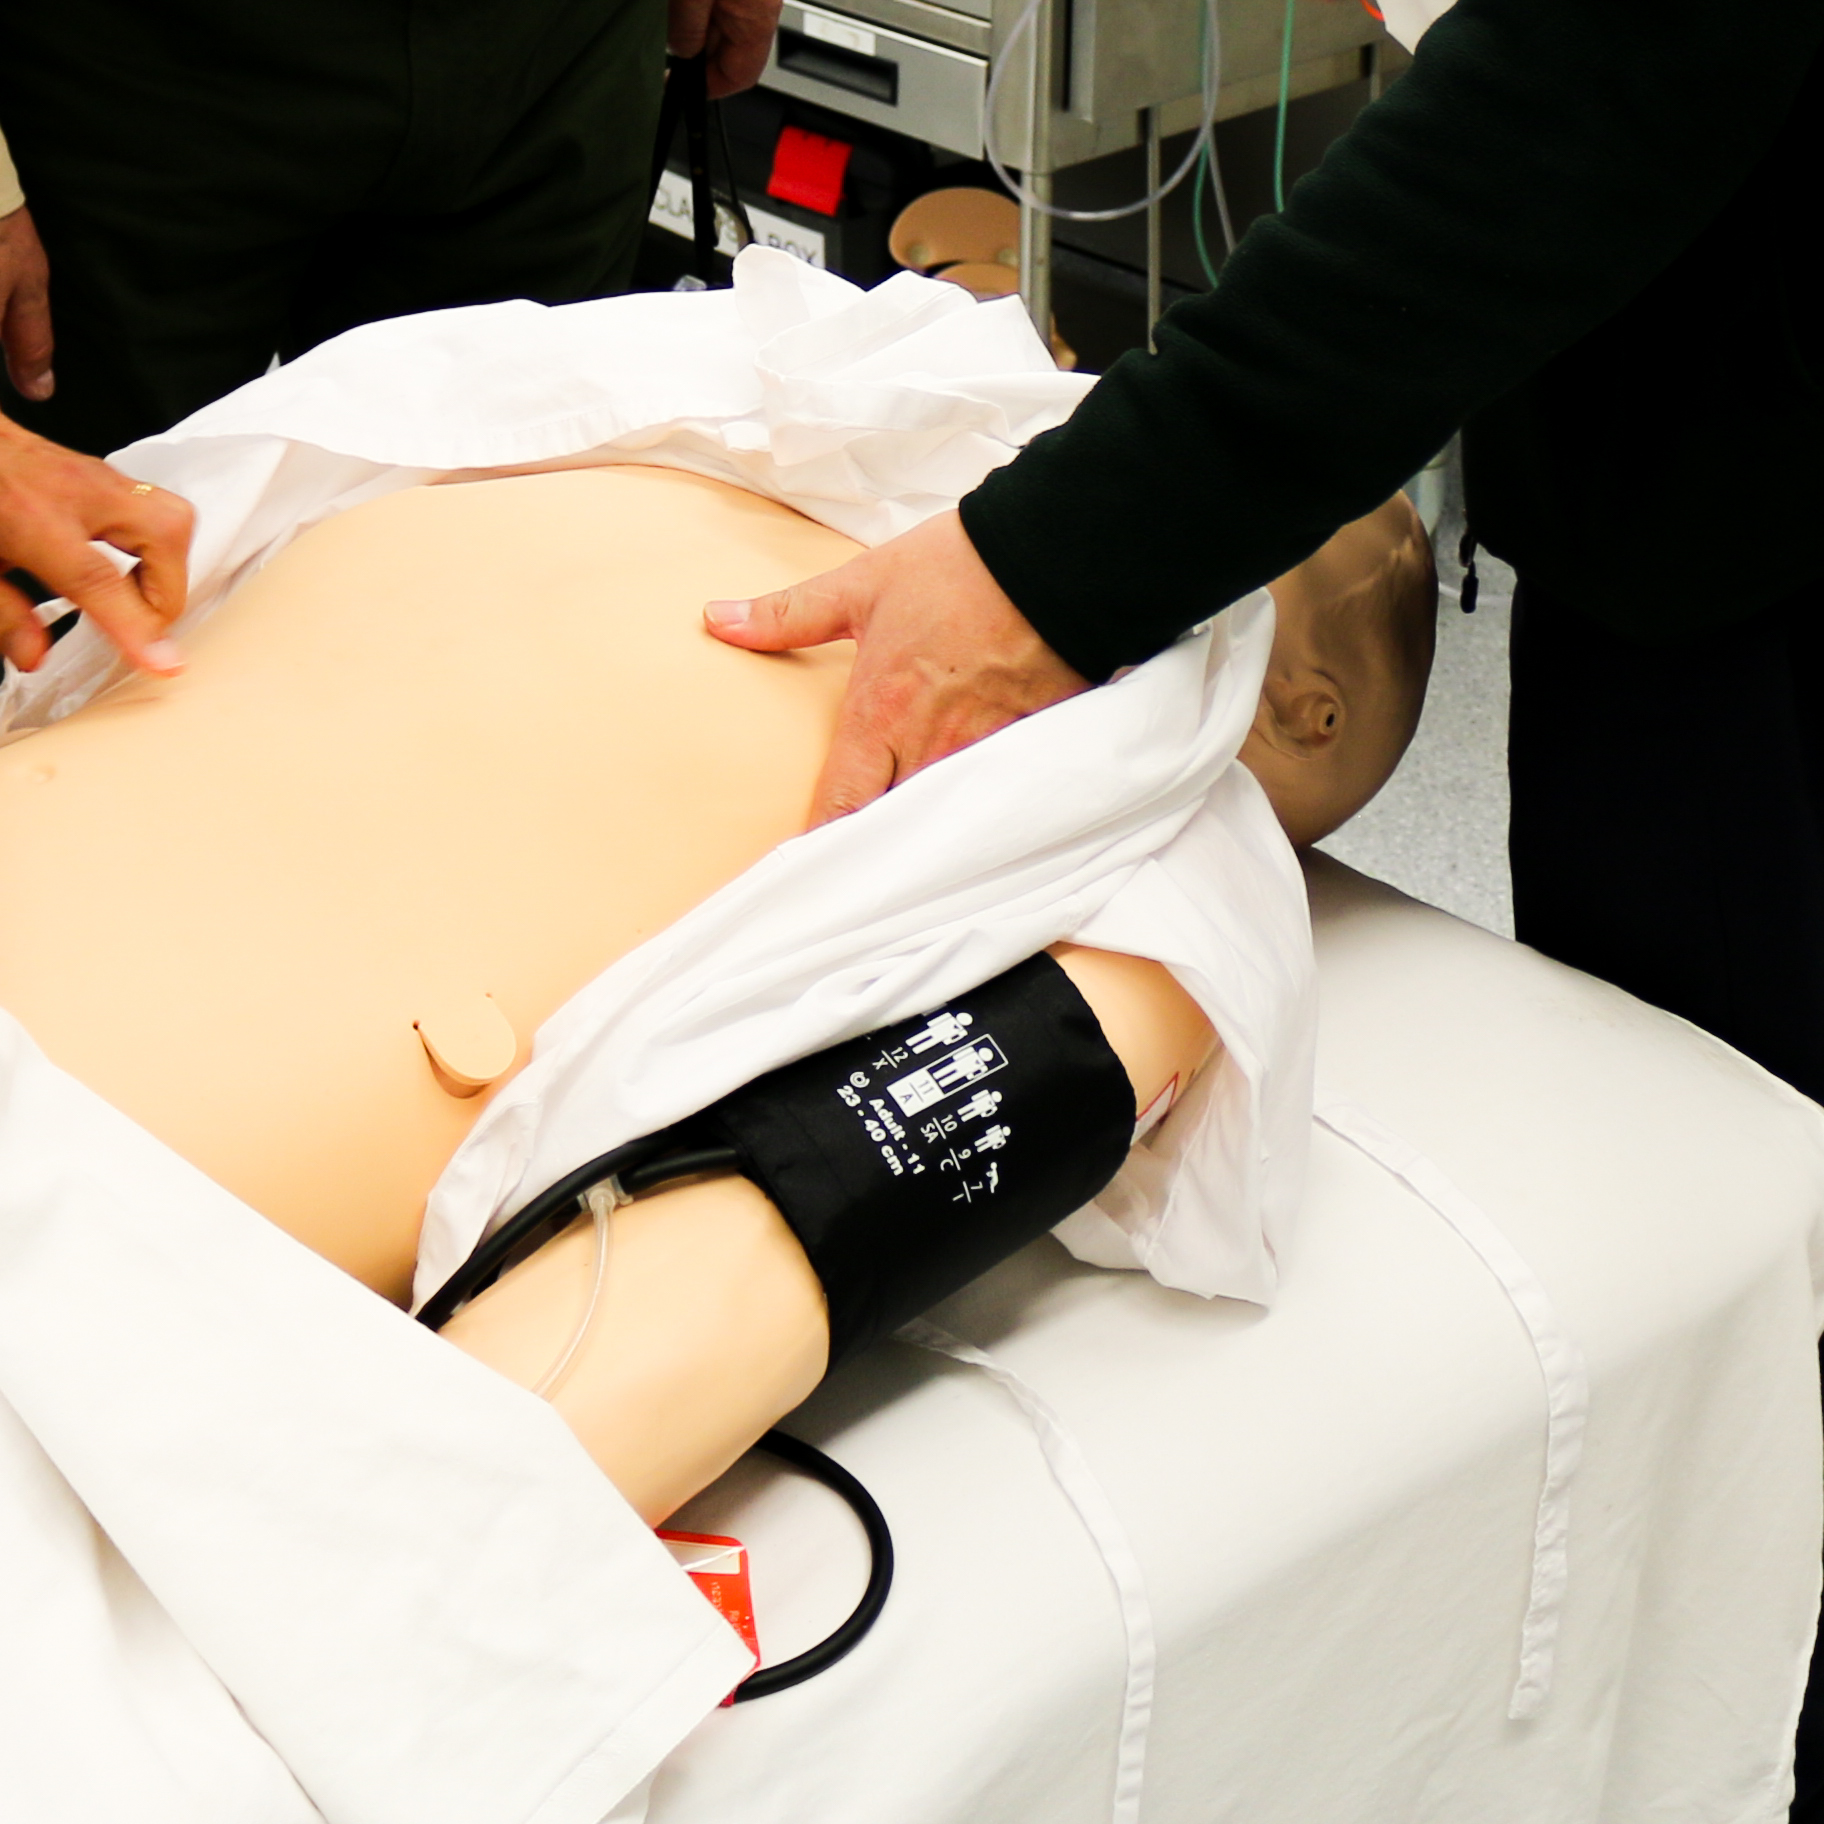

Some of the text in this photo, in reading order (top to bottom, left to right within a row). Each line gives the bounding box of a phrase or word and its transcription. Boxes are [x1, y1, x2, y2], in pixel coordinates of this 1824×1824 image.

[891, 1046, 909, 1063] 12
[872, 1057, 888, 1070] X
[917, 1080, 935, 1095] 11
[899, 1092, 914, 1104] A
[836, 1085, 862, 1107] 23
[864, 1119, 887, 1142] 40
[881, 1145, 904, 1176] cm
[941, 1114, 958, 1132] 10
[868, 1098, 906, 1142] Adult
[907, 1152, 926, 1175] 11
[920, 1122, 939, 1143] SA
[957, 1148, 972, 1160] 9
[940, 1158, 954, 1172] C
[970, 1181, 984, 1190] 7
